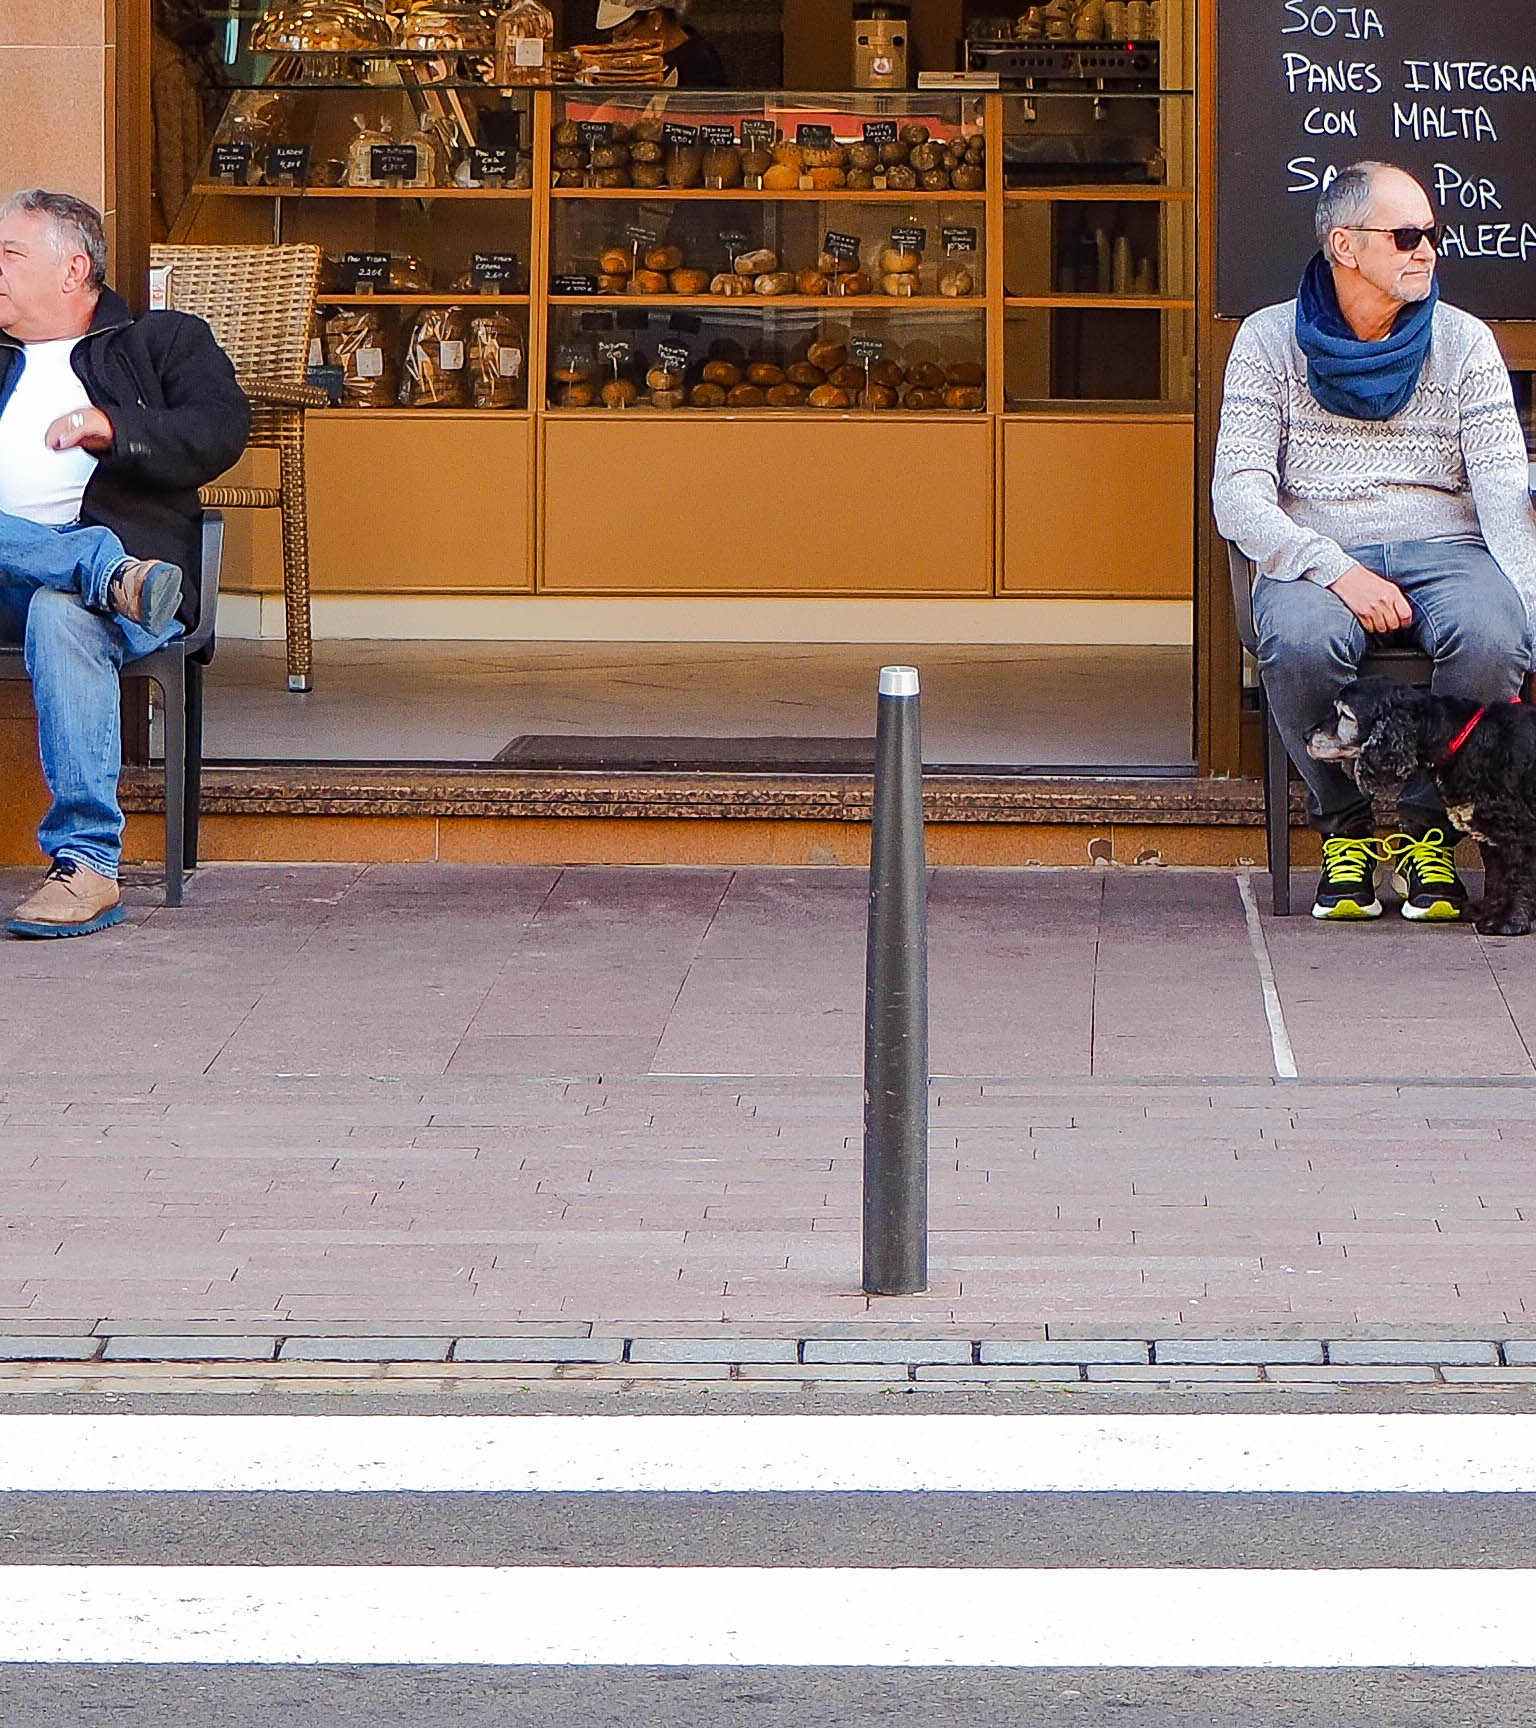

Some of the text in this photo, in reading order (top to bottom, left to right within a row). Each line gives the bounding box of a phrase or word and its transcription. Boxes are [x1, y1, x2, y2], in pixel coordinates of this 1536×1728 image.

[1282, 52, 1383, 94] PANES
[1303, 101, 1498, 142] CON MALTA
[1432, 162, 1503, 210] POR
